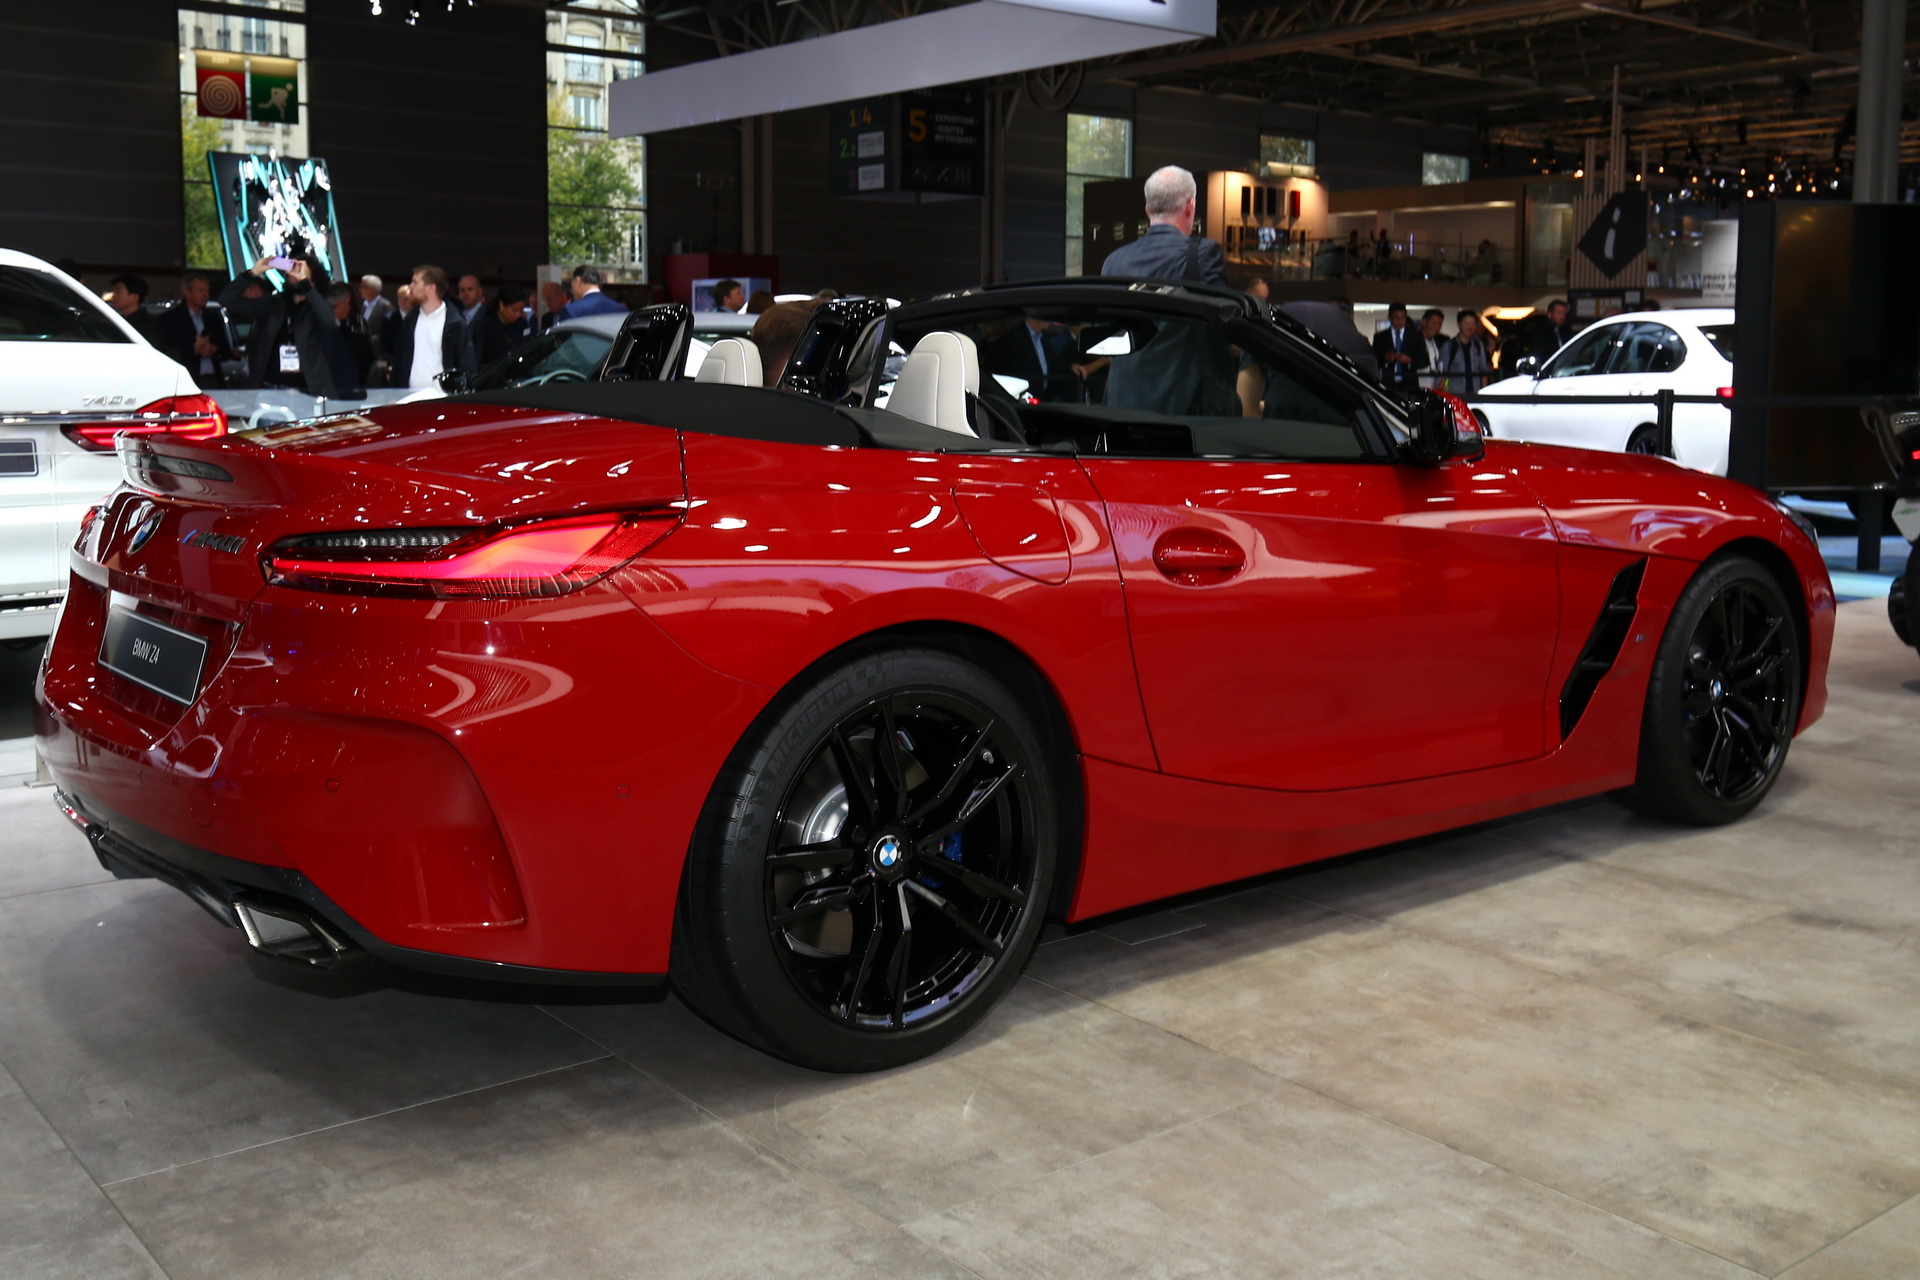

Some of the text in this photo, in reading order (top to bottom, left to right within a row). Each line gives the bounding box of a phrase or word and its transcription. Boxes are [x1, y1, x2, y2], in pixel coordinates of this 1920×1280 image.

[907, 108, 927, 143] 5
[848, 169, 857, 190] 3
[132, 637, 161, 665] BMW Z4
[768, 680, 854, 777] MICHELIN
